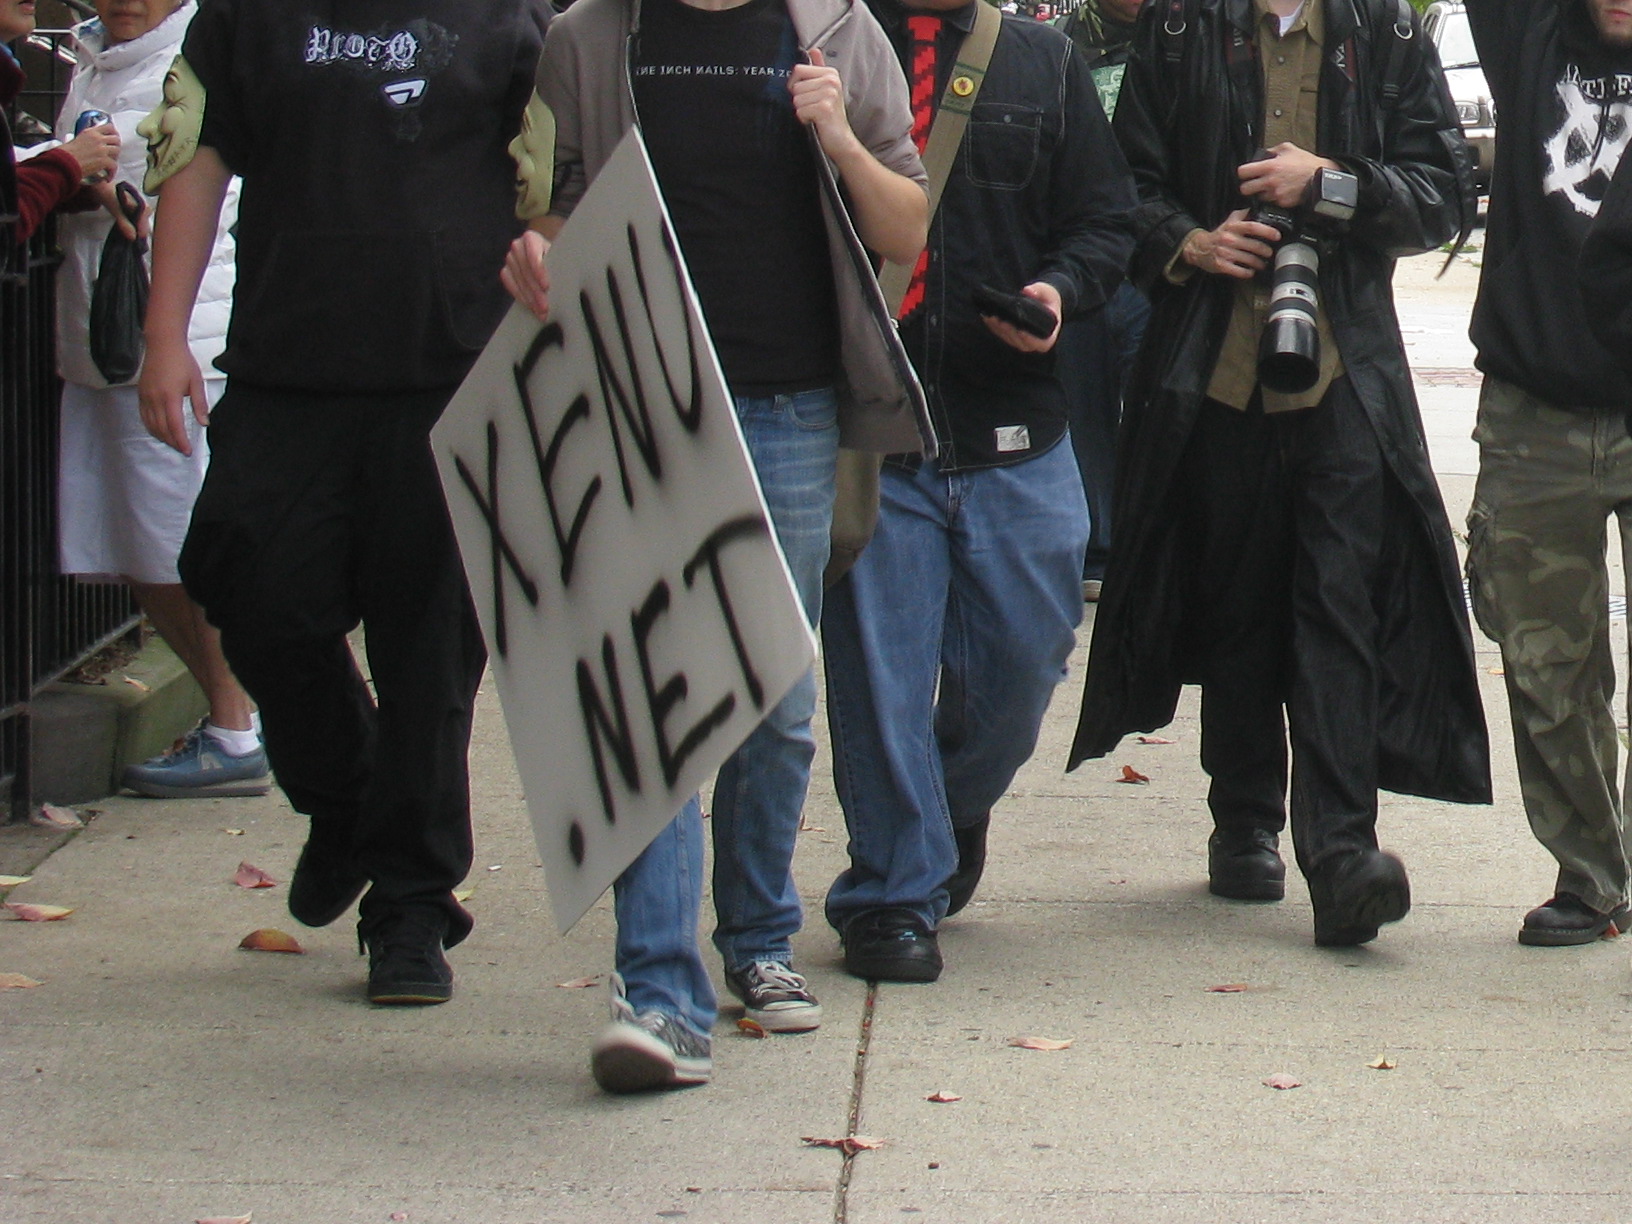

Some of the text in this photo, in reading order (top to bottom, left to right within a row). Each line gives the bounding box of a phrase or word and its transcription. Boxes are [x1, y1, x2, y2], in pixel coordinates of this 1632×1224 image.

[660, 64, 692, 76] INCH
[742, 65, 776, 77] YEAR
[450, 217, 702, 662] XENU
